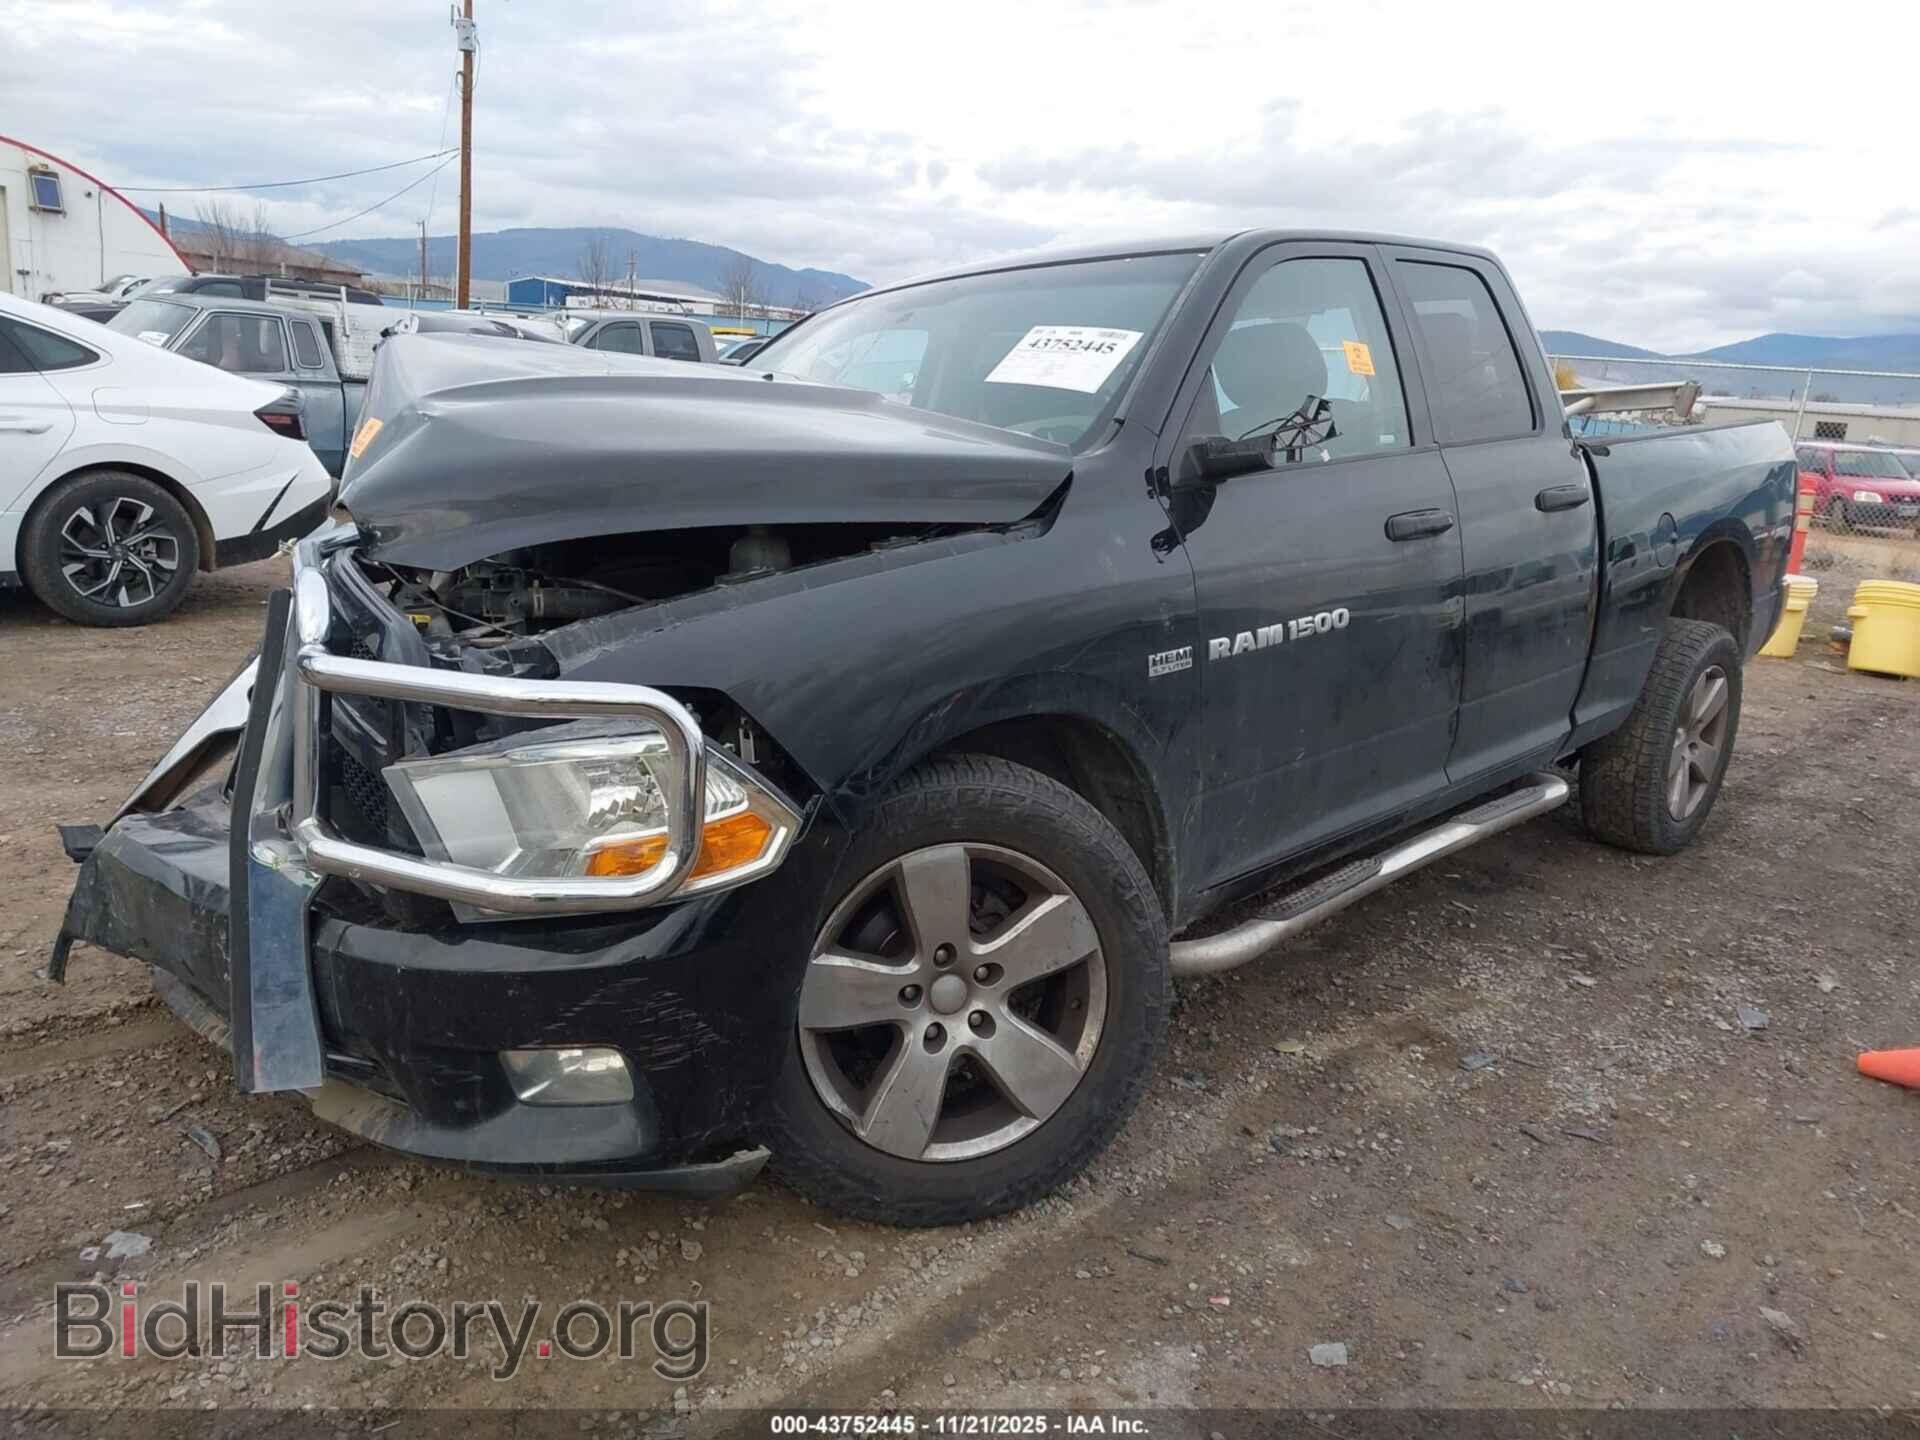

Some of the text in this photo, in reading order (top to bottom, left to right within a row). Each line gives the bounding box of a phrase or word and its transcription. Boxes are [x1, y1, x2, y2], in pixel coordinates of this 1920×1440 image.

[1028, 337, 1118, 354] 43752445
[1208, 607, 1350, 661] RAM 1500
[1151, 648, 1192, 667] HEMI
